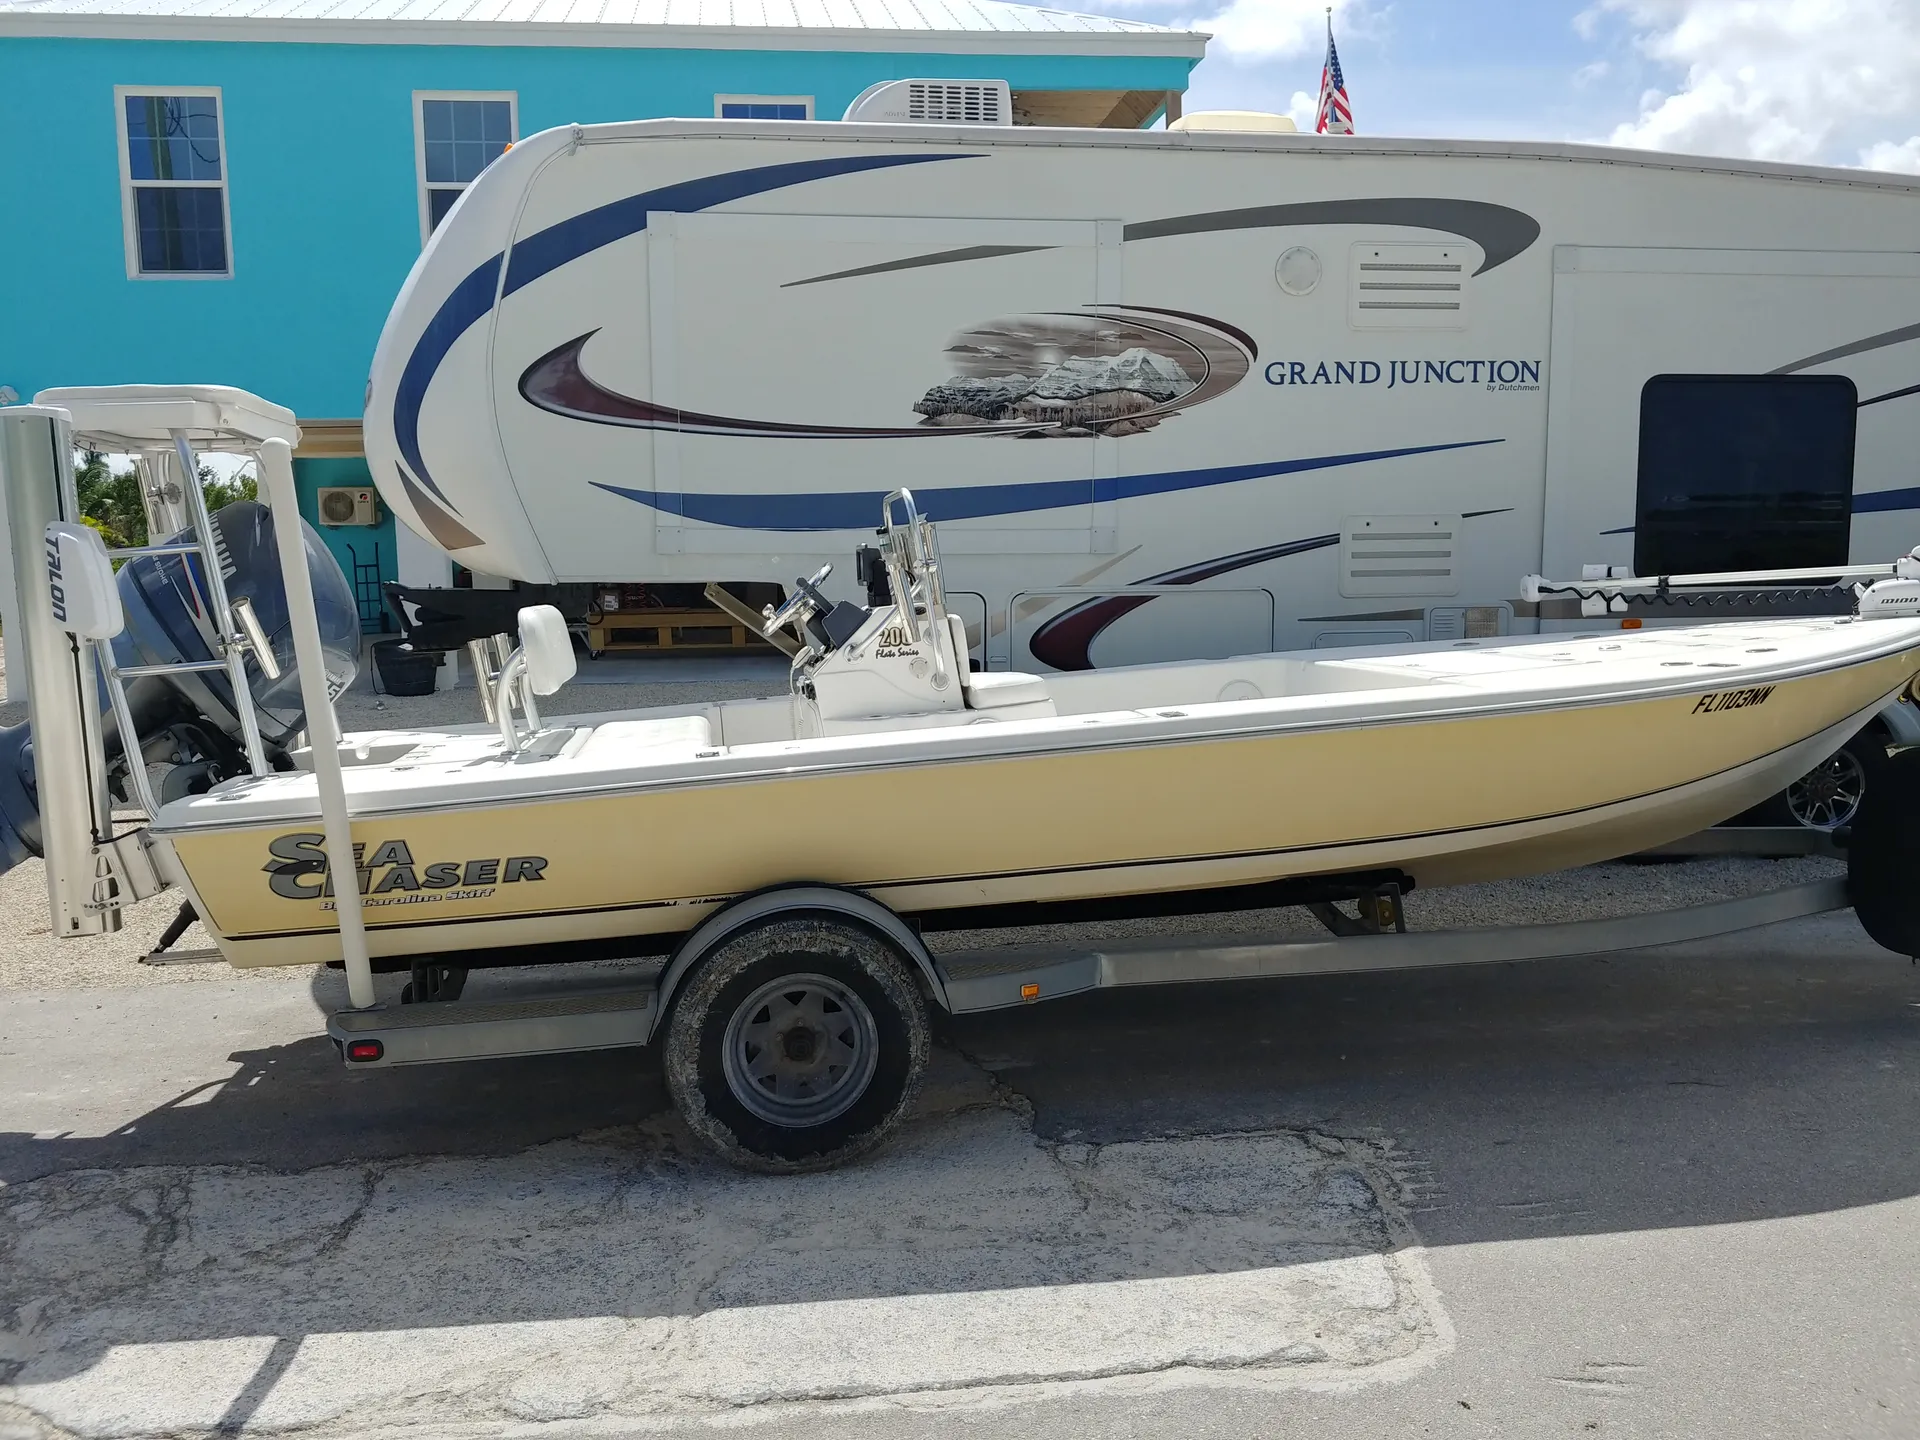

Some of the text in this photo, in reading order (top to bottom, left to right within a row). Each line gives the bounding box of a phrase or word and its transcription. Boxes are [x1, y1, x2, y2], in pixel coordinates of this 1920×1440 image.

[1264, 360, 1542, 389] GRAND JUNCTION
[1486, 384, 1496, 392] by
[875, 647, 920, 660] Flats Series
[319, 888, 496, 912] B Carolina Skiff
